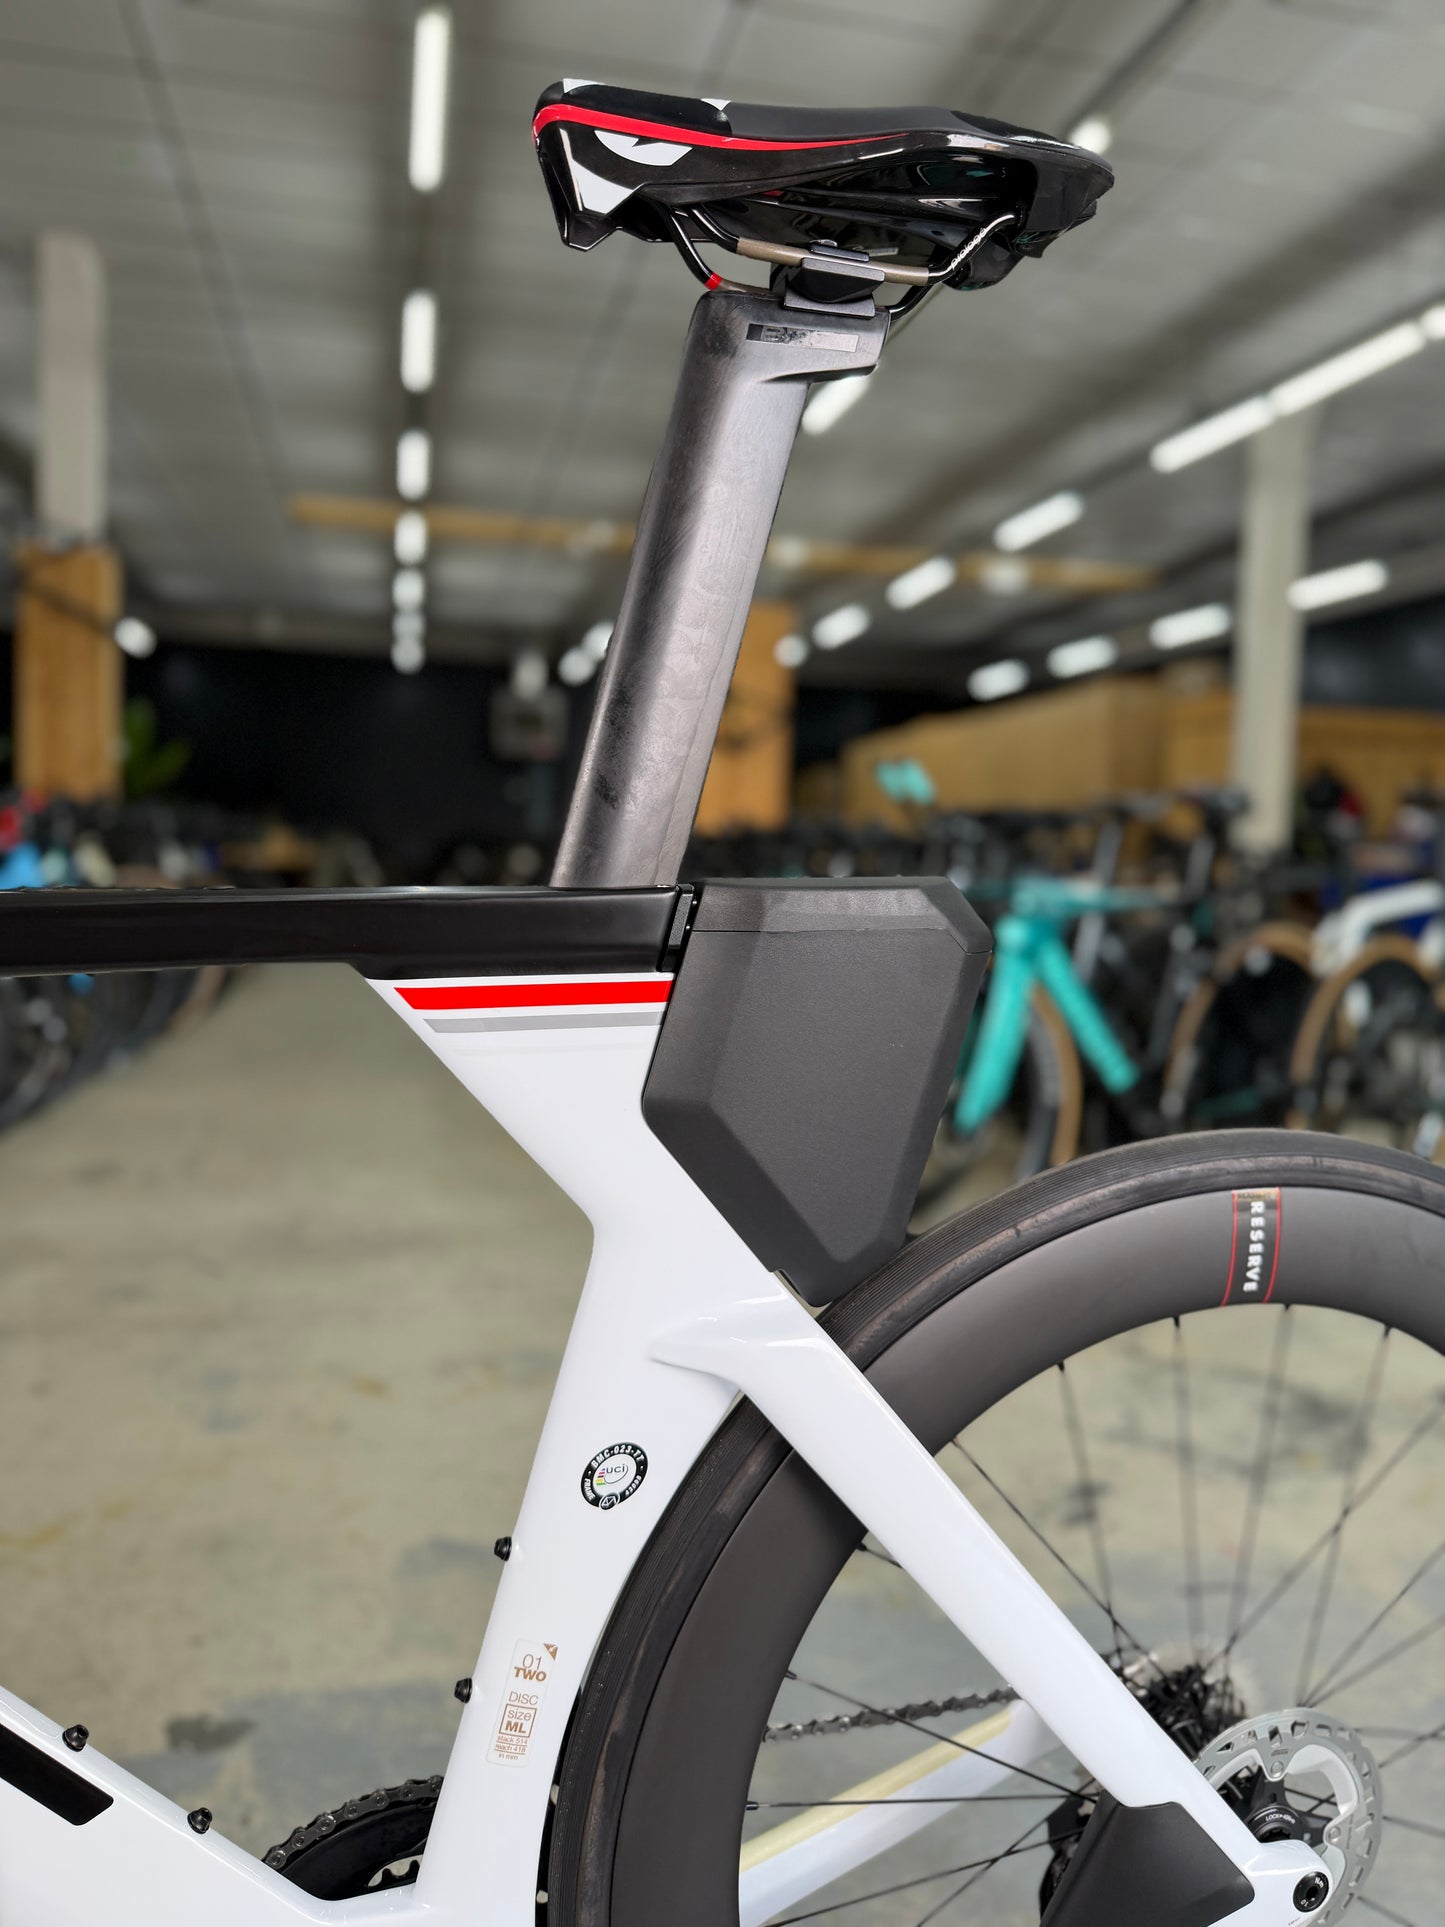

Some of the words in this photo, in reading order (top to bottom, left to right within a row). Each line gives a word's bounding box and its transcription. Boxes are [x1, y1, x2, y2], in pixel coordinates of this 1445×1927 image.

[1243, 1200, 1265, 1292] RESERVE
[522, 1653, 542, 1670] 01
[514, 1666, 547, 1682] TWO
[508, 1691, 539, 1705] DISC
[507, 1708, 532, 1721] size
[505, 1720, 526, 1733] ML
